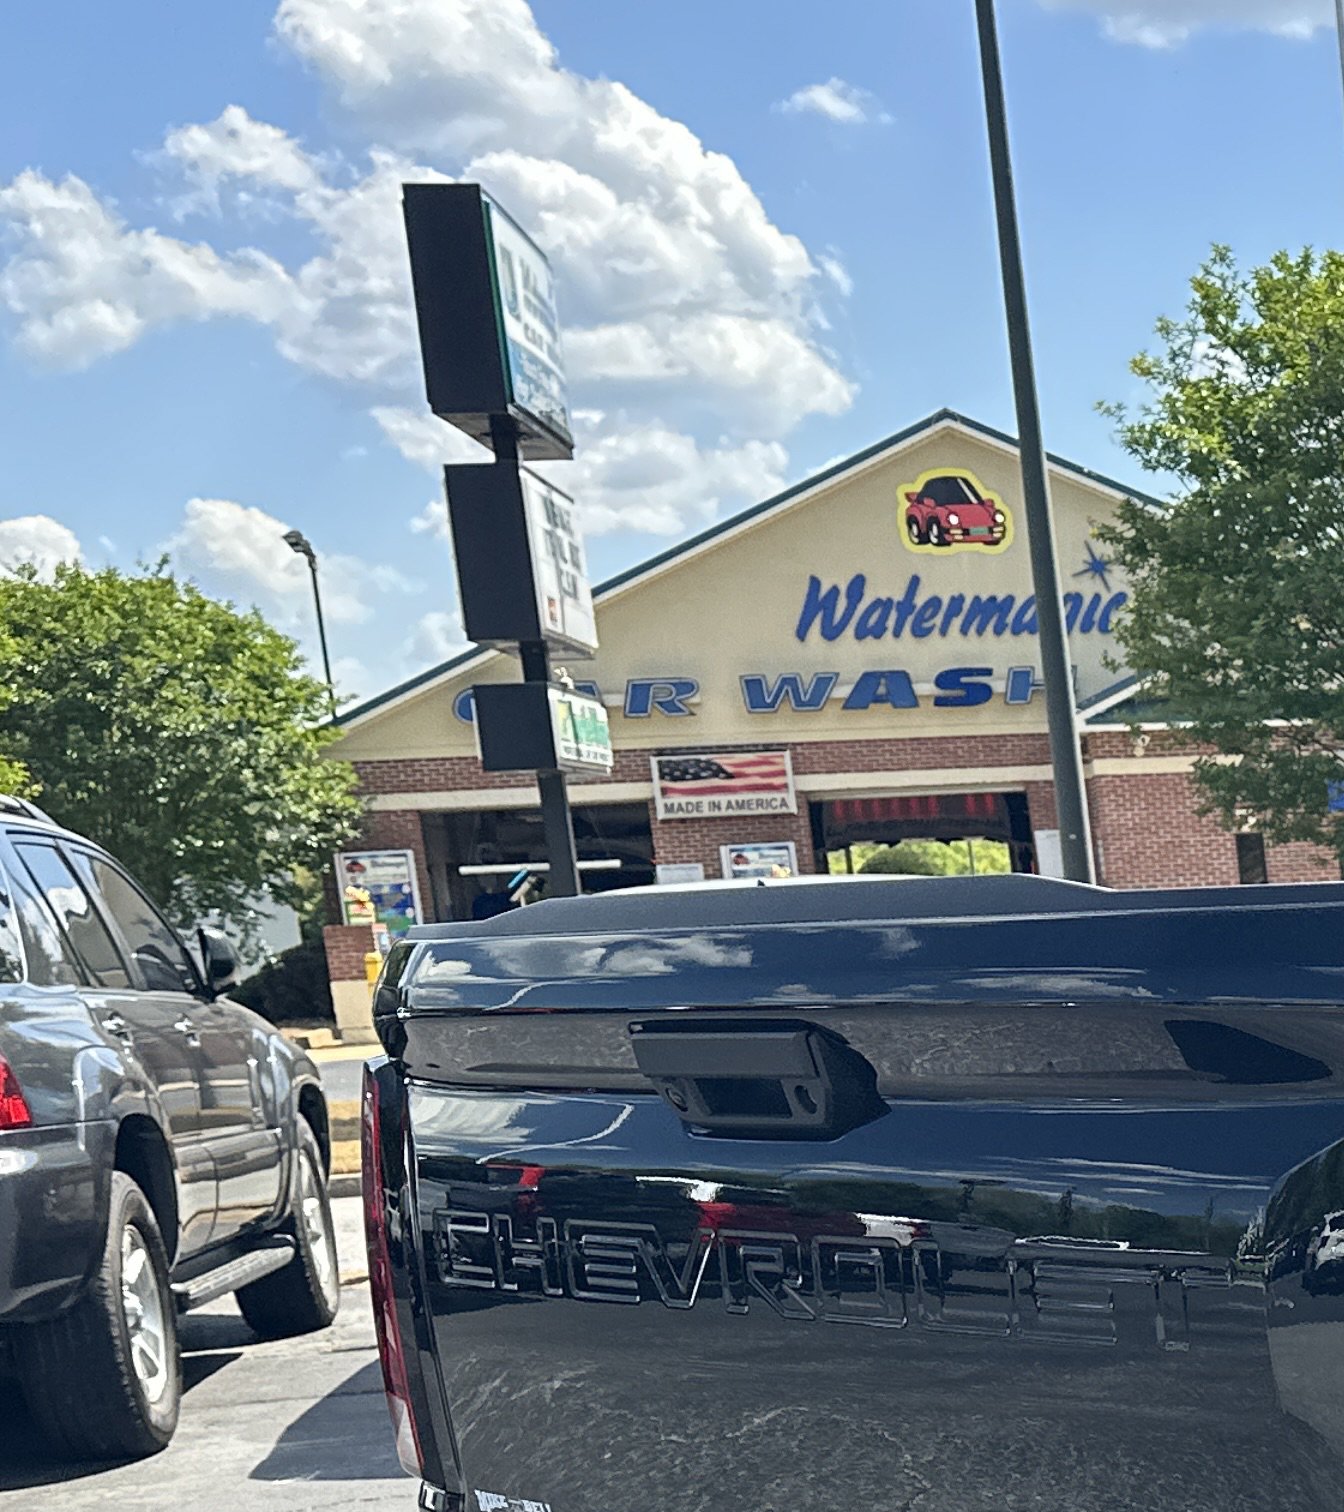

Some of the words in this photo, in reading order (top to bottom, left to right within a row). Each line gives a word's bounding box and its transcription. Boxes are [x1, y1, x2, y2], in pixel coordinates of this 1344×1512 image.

[663, 800, 703, 815] MADE
[708, 800, 722, 812] IN
[725, 797, 790, 812] AMERICA
[432, 1206, 1232, 1353] CHEVROLET
